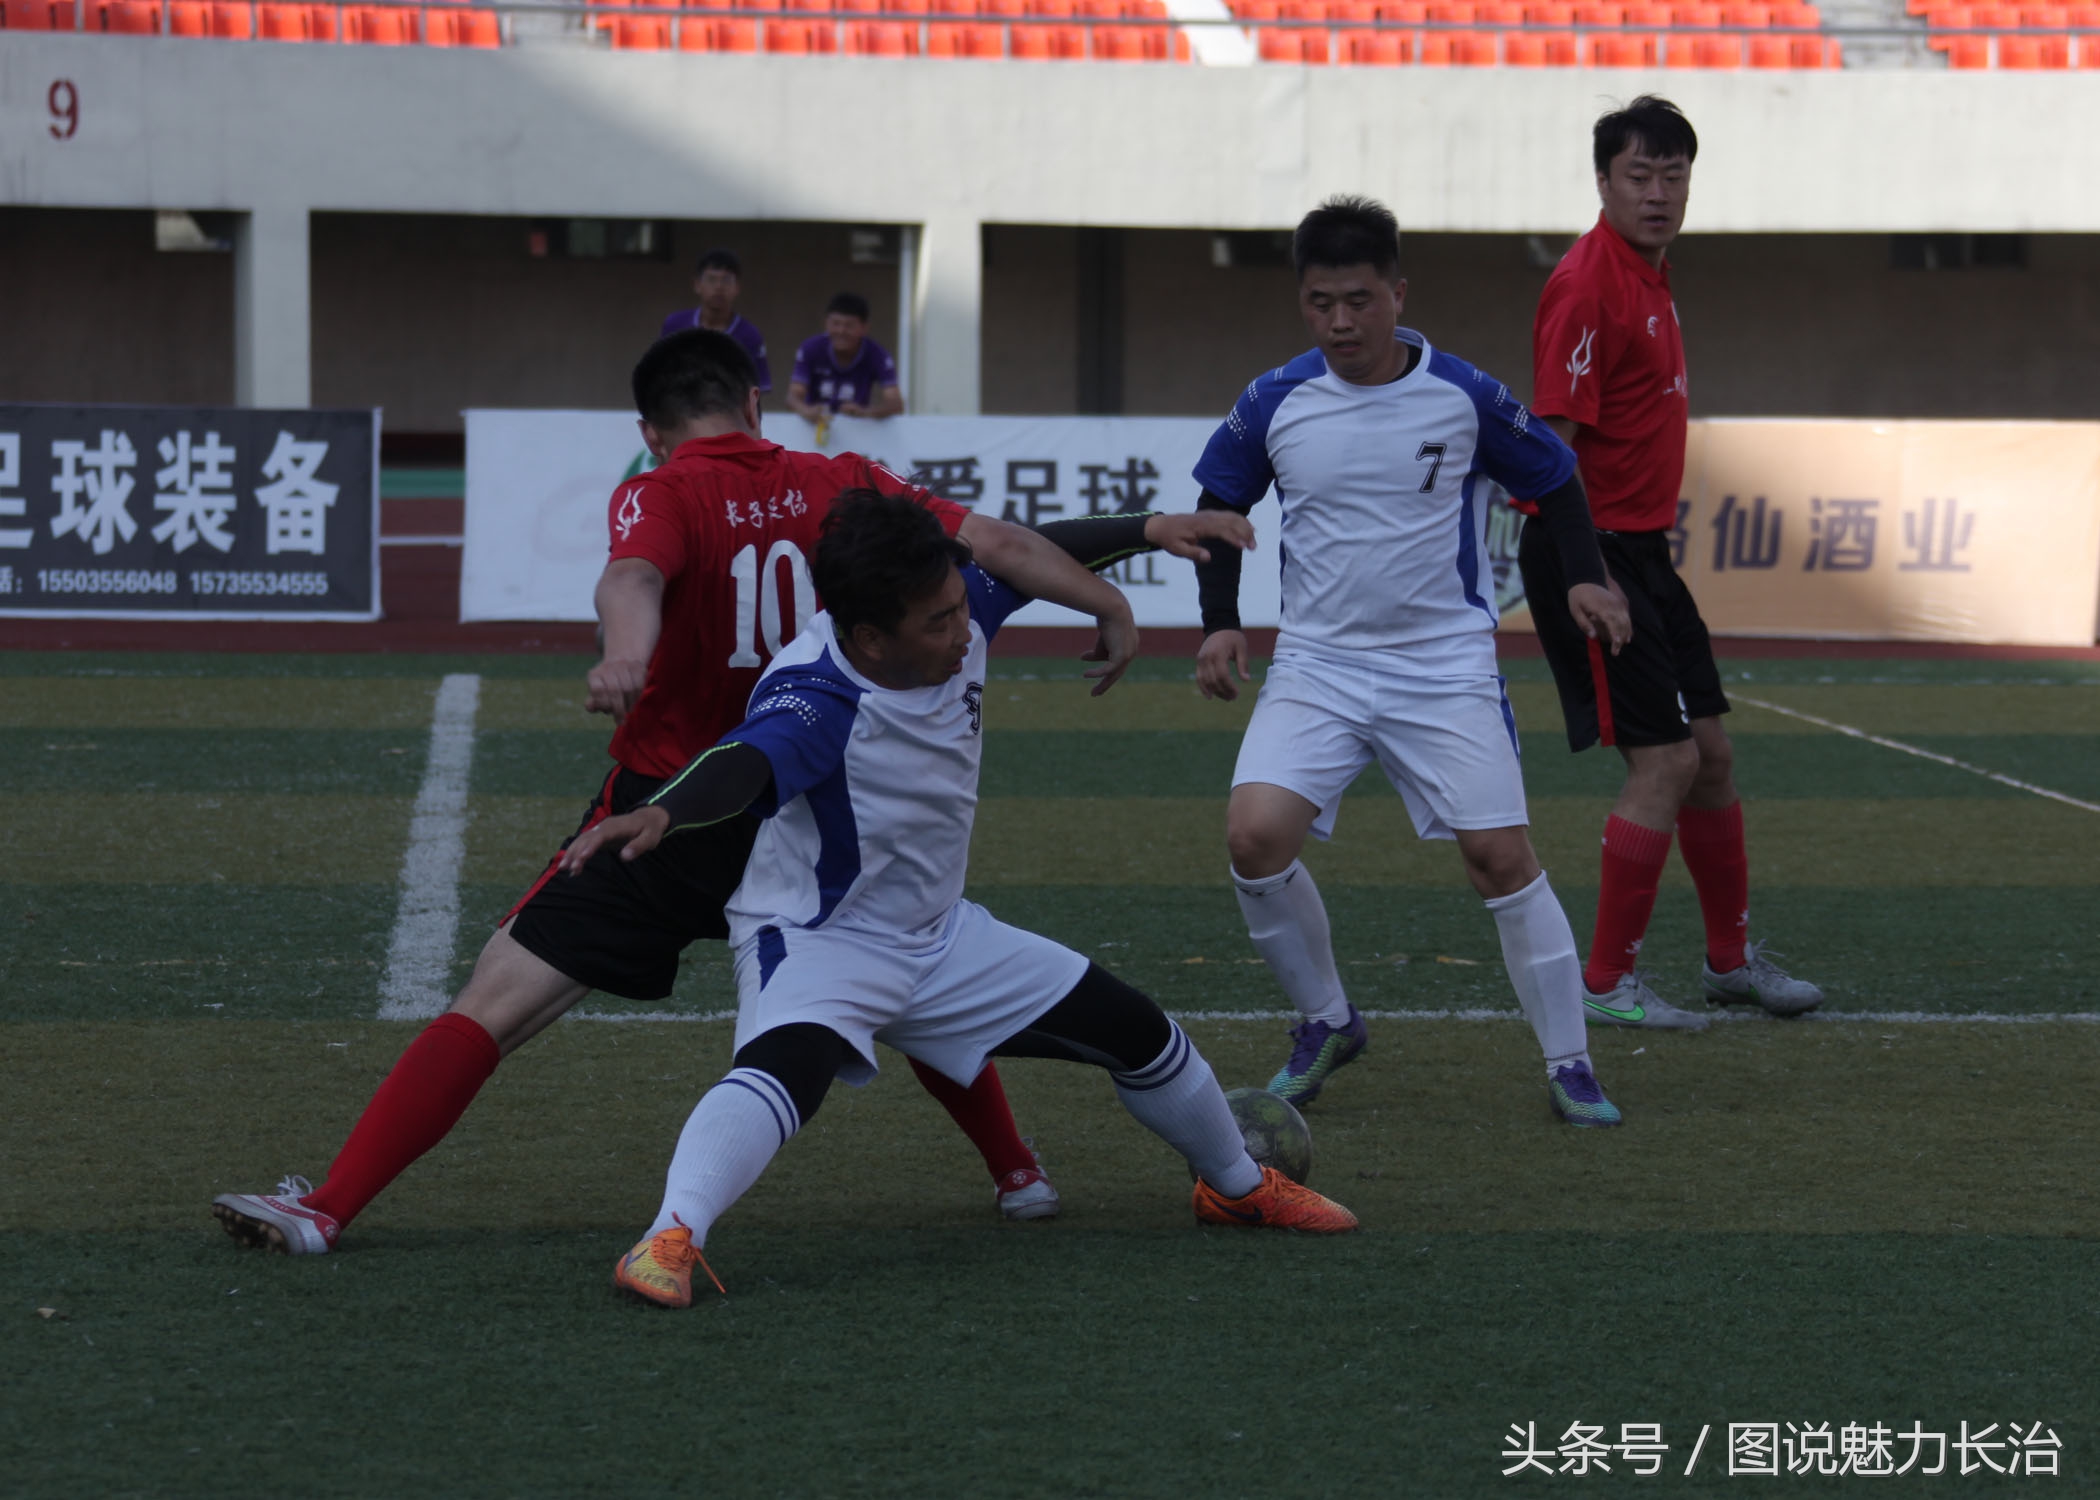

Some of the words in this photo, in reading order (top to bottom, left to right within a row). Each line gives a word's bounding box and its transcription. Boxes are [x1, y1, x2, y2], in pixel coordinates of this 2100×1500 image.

[49, 79, 78, 138] 9
[866, 456, 1159, 527] 爱足球
[1415, 441, 1448, 494] 7
[38, 569, 177, 594] 15503556048
[190, 571, 329, 596] 15735534555
[728, 539, 817, 668] 10
